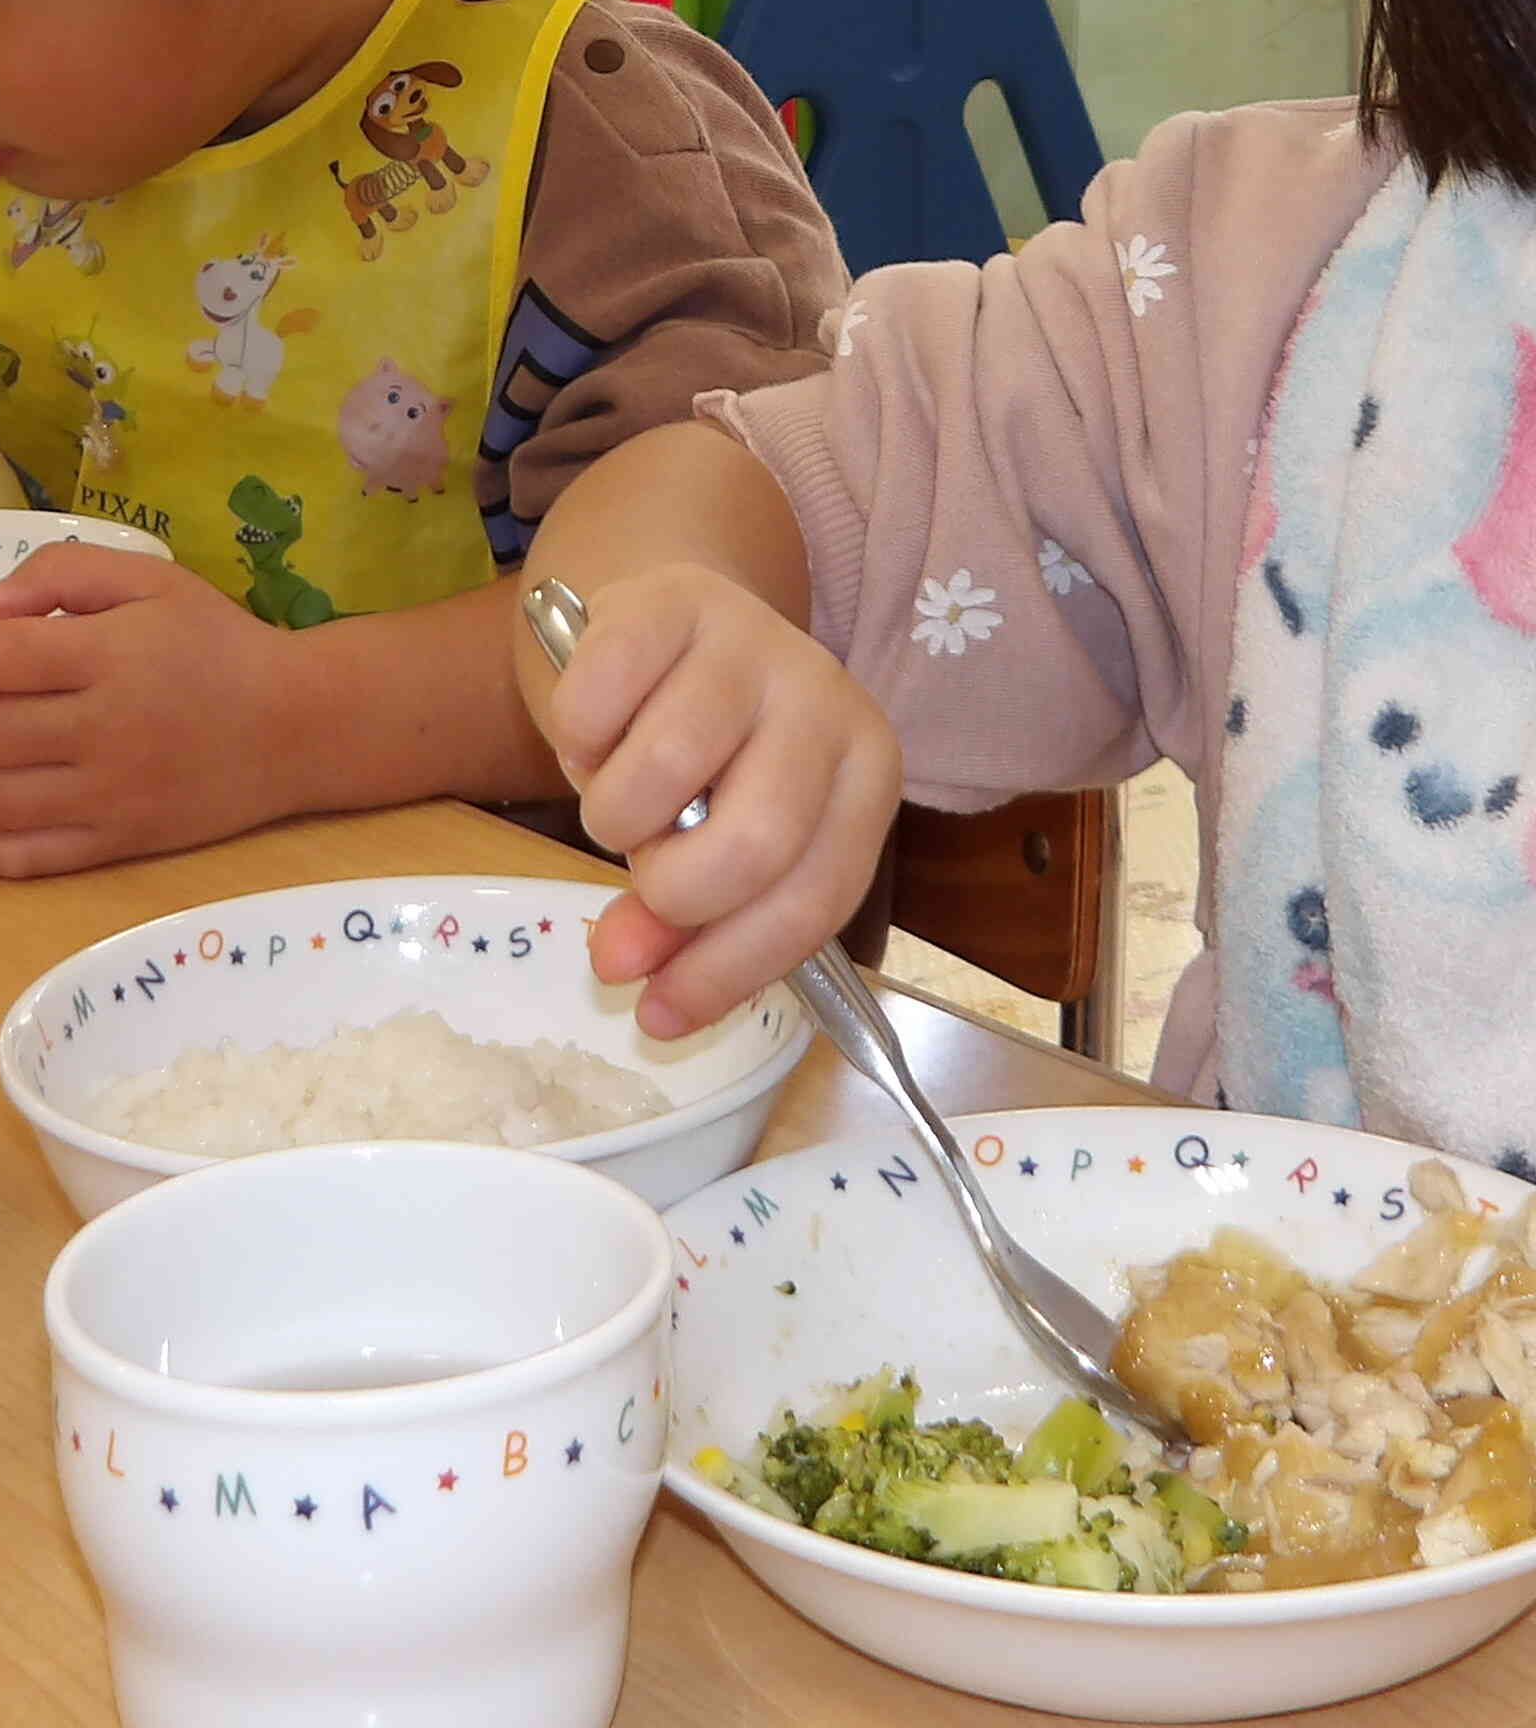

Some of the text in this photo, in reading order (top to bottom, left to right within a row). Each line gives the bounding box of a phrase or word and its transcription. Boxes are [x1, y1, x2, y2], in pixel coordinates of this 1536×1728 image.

[80, 483, 172, 539] PIXAR
[71, 985, 97, 1028] M
[134, 958, 167, 1003] N
[198, 929, 224, 961] O
[268, 934, 288, 968] P
[342, 908, 383, 943] Q
[432, 914, 461, 949] R
[507, 925, 533, 959] S
[742, 1185, 781, 1228] M
[876, 1153, 920, 1199] N
[973, 1134, 1005, 1168] O
[1070, 1148, 1094, 1182] P
[1173, 1134, 1218, 1170] Q
[1286, 1156, 1320, 1195] R
[1378, 1186, 1406, 1222] S
[106, 1395, 636, 1532] L M A B C
